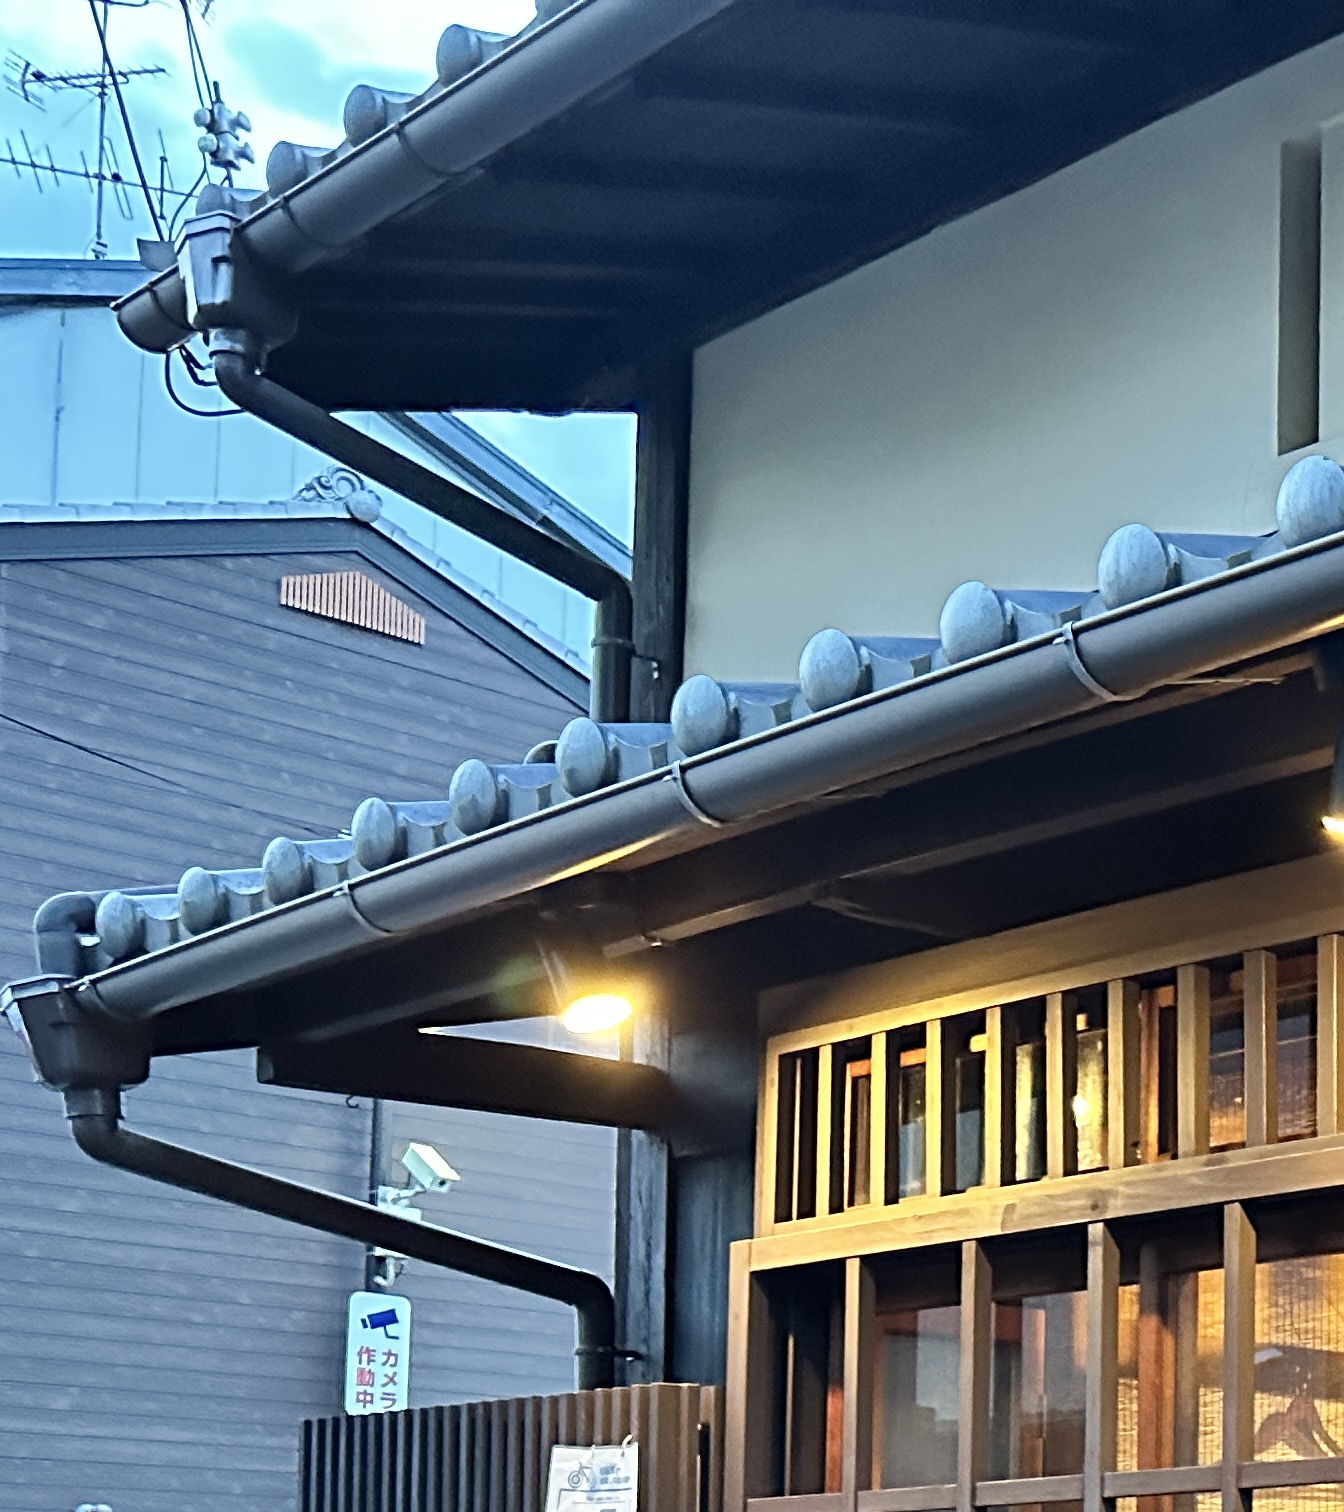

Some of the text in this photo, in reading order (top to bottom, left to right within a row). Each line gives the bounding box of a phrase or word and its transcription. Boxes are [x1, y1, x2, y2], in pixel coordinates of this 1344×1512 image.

[355, 1345, 377, 1409] 作動中
[380, 1349, 399, 1409] カメラ
